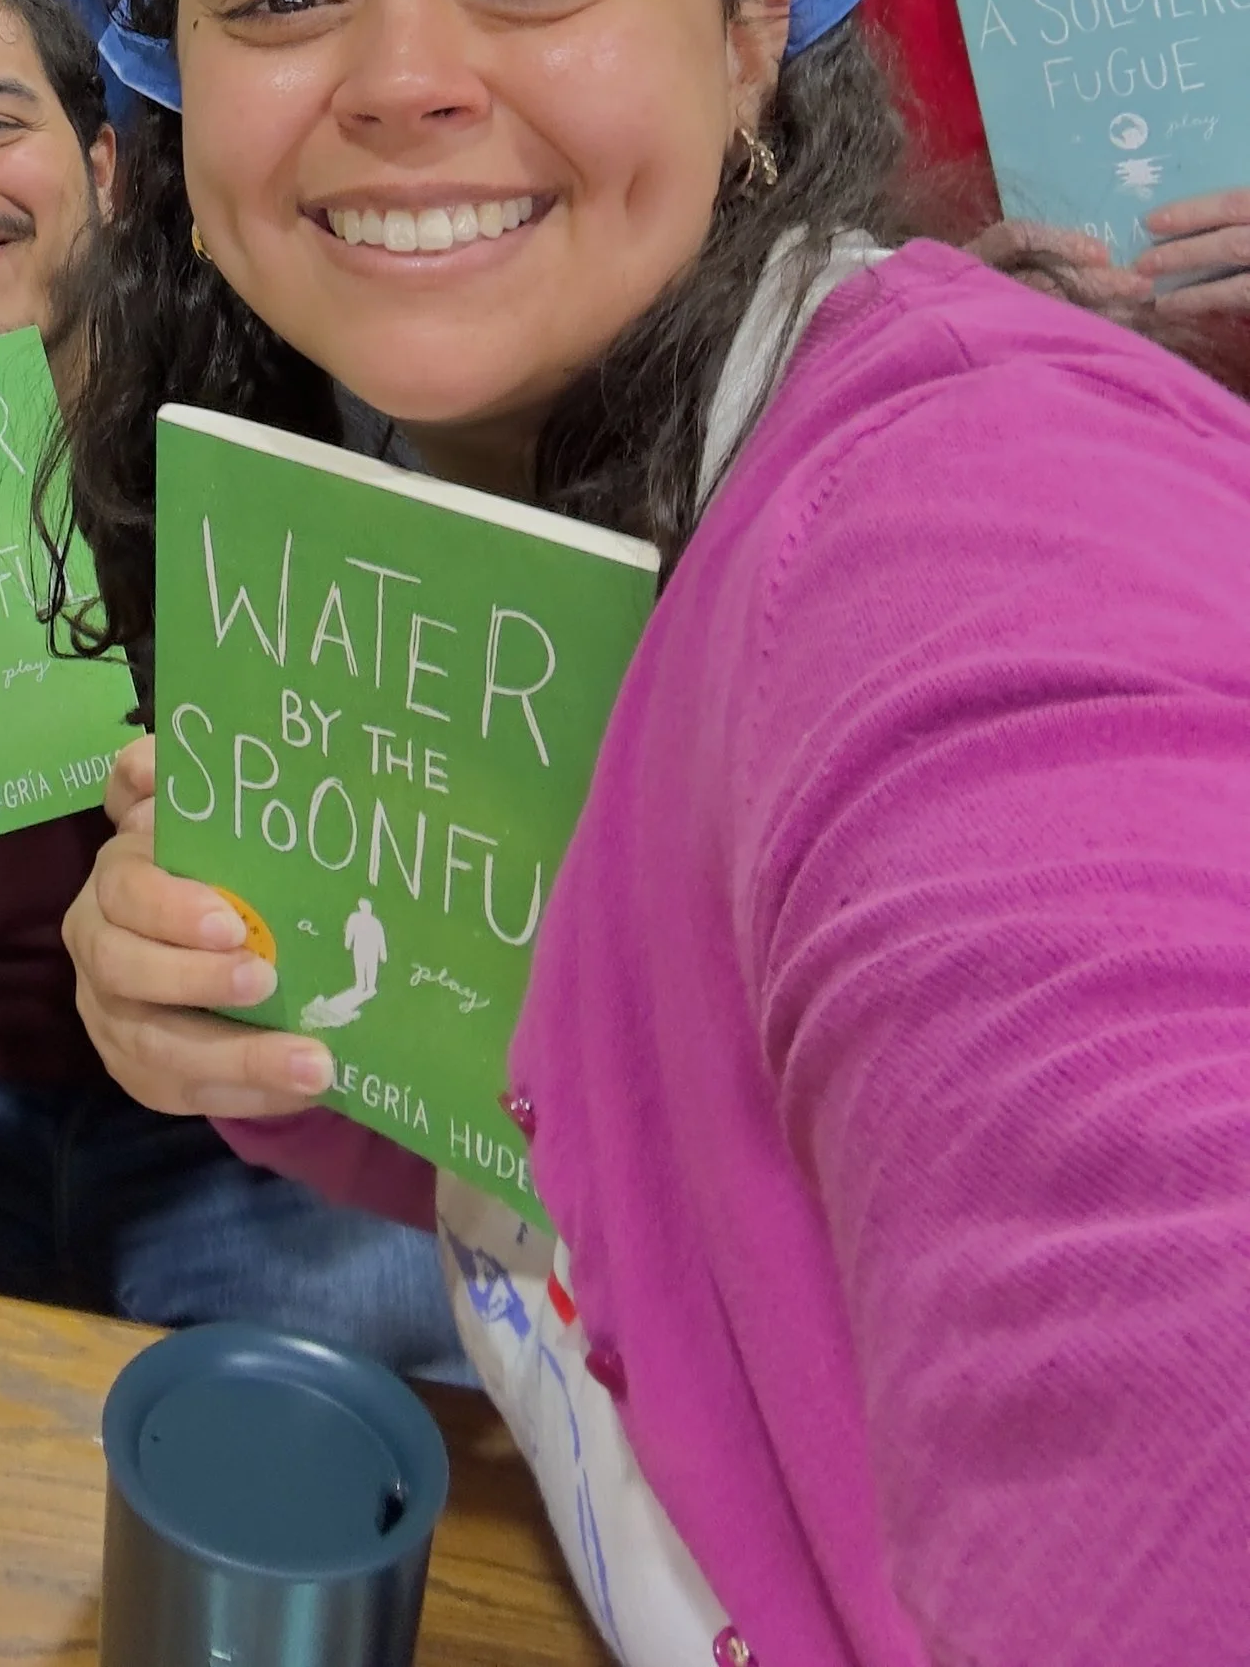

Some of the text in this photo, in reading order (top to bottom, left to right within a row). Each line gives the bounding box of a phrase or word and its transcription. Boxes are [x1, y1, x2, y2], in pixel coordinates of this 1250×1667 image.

[1042, 37, 1207, 109] FUGUE
[1165, 112, 1221, 140] play
[2, 657, 51, 690] play
[201, 513, 557, 767] WATER
[59, 751, 113, 791] HUD
[280, 688, 451, 795] BY THE
[166, 702, 543, 948] SPOONFU
[297, 919, 320, 936] a
[410, 962, 492, 1013] play
[331, 1057, 541, 1200] LEGRÍA HUDE
